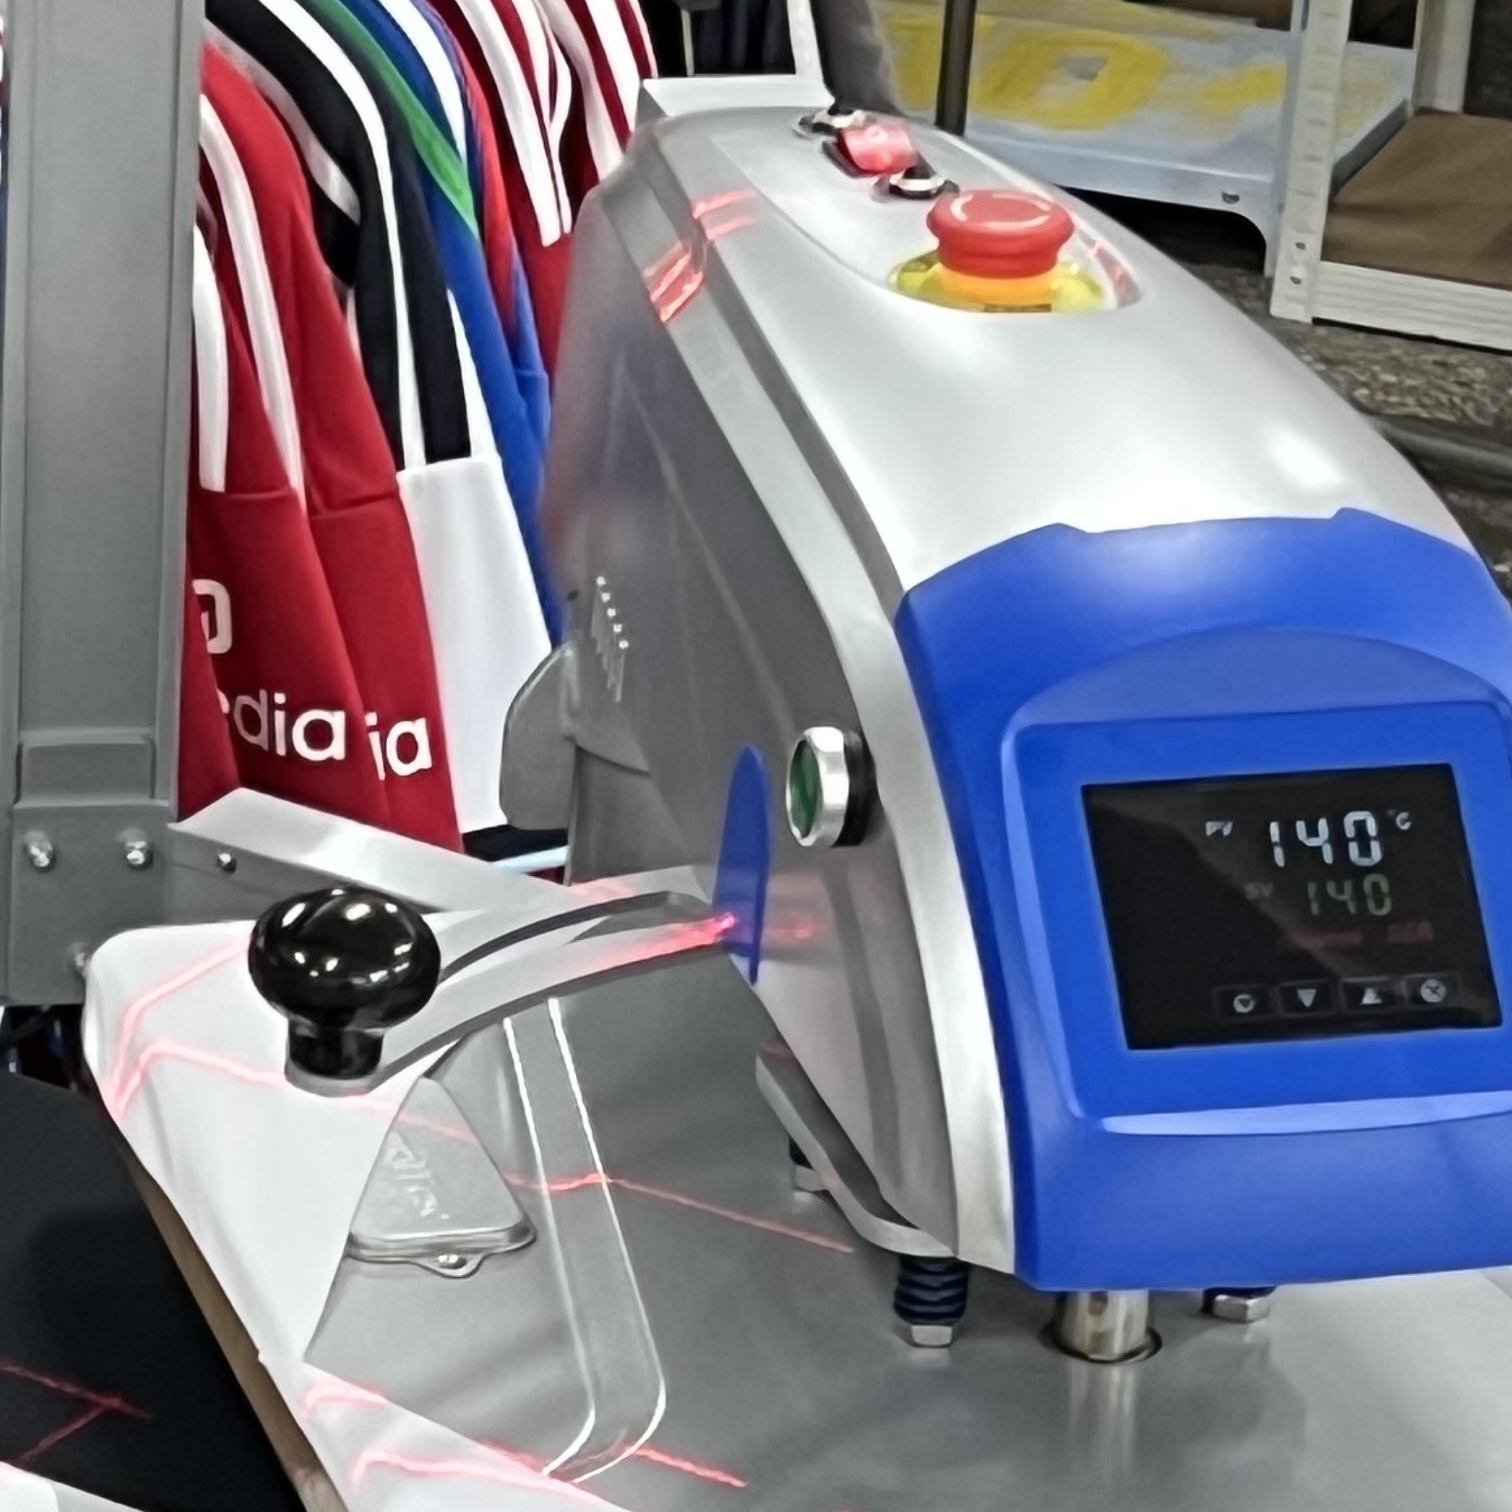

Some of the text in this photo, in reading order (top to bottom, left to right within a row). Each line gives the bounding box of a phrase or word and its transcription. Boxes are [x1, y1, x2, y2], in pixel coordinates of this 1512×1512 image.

[218, 689, 347, 762] dia
[1269, 810, 1384, 868] 140
[1307, 872, 1393, 917] 140
